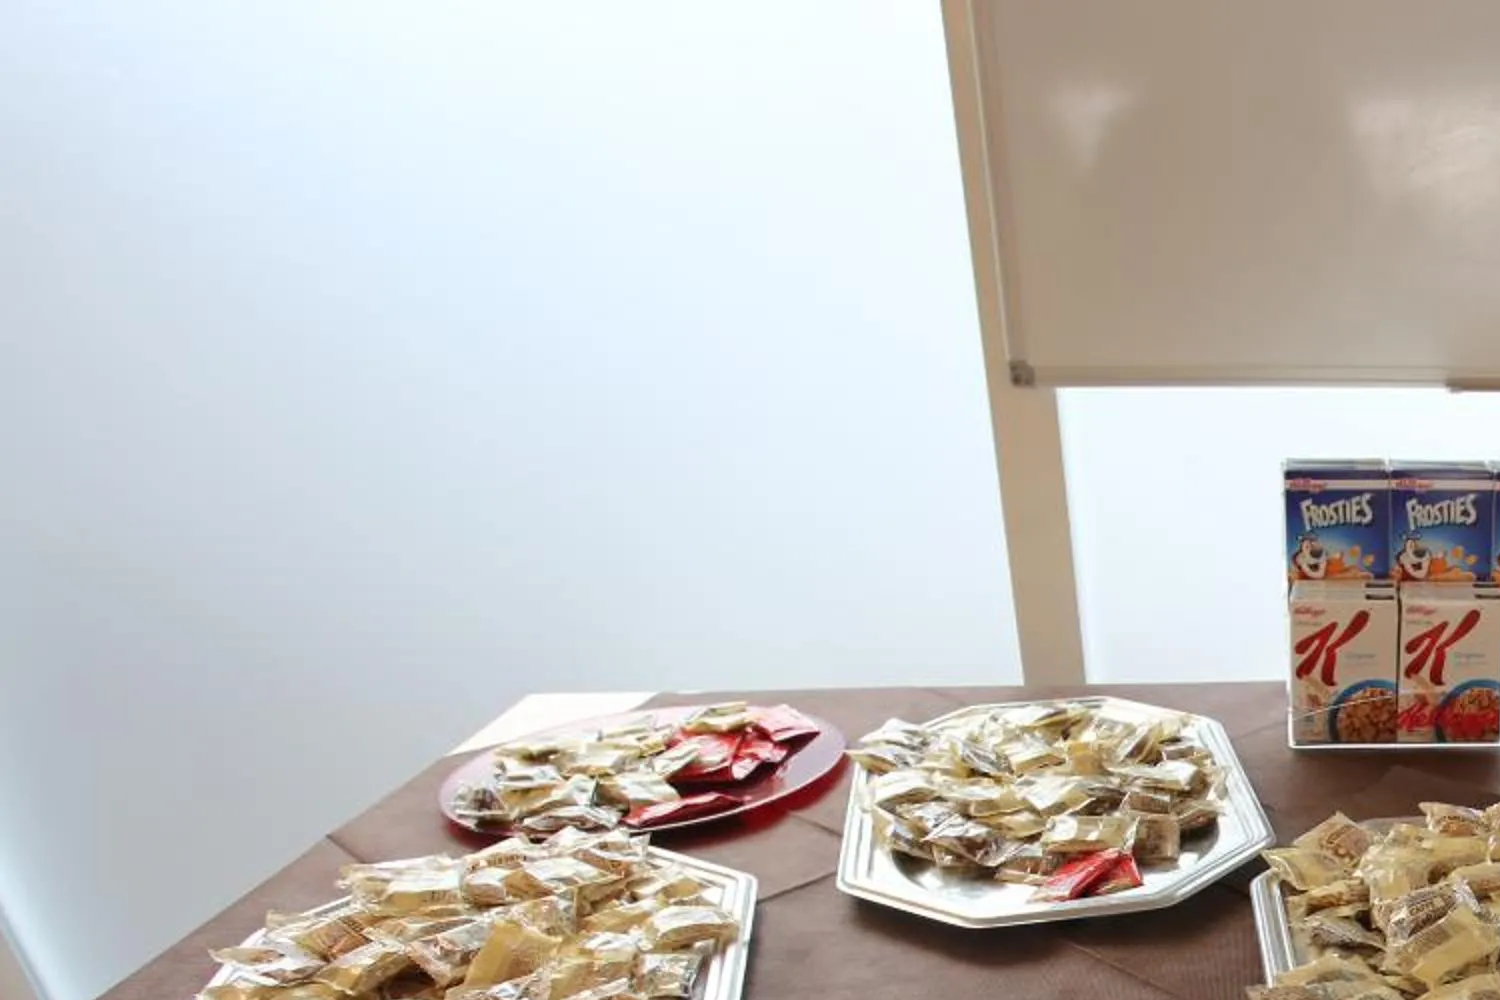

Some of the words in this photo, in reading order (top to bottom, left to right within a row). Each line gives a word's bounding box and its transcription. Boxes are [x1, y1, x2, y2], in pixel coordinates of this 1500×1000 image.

[1301, 493, 1374, 531] FROSTIES
[1406, 493, 1477, 531] FROSTIES
[1295, 609, 1370, 687] K
[1404, 609, 1481, 687] K
